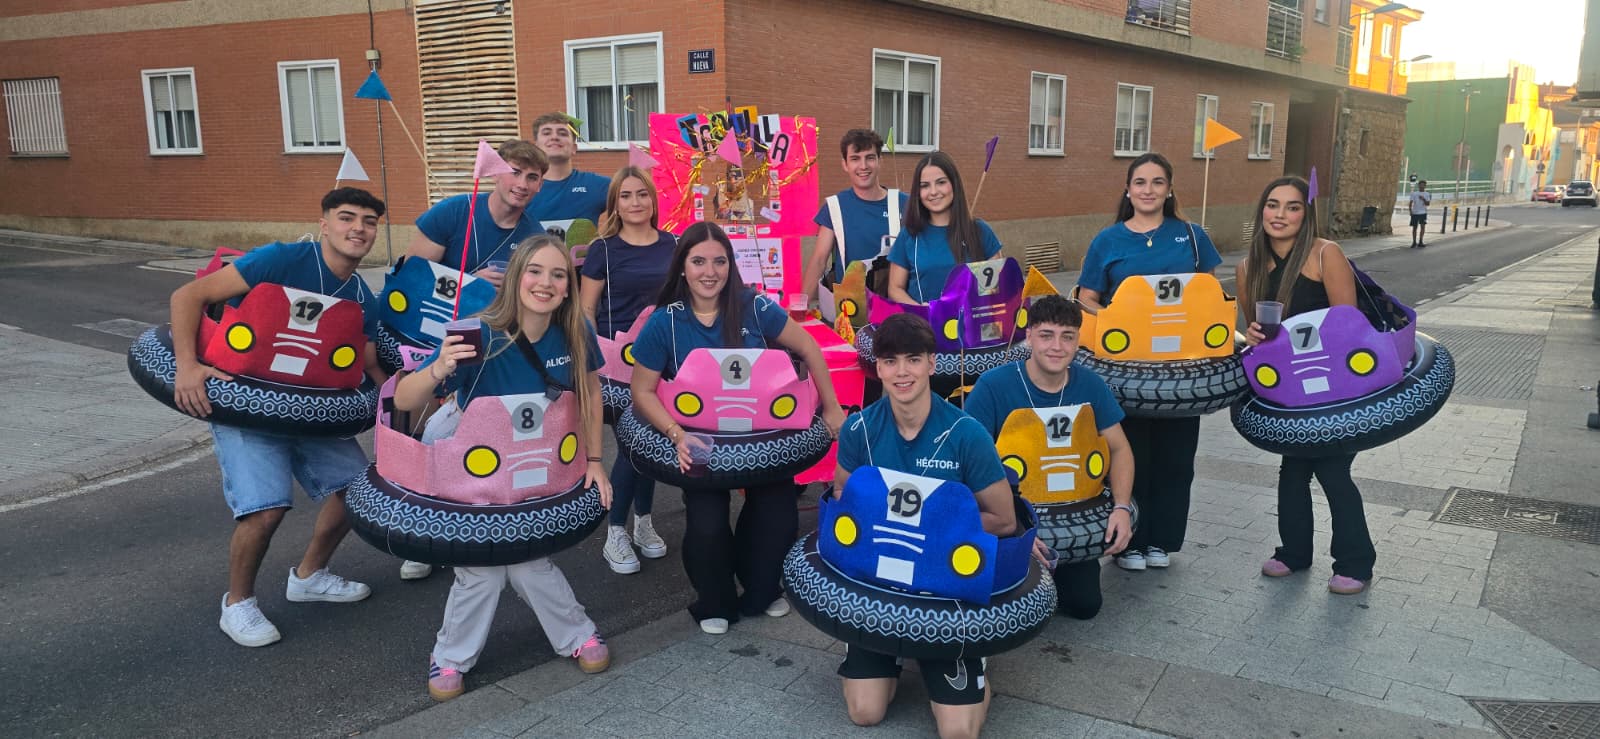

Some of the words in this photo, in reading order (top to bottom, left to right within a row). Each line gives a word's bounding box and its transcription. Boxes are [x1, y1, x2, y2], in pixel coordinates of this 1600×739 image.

[692, 61, 709, 70] NUEVA
[436, 276, 457, 299] 18
[982, 266, 994, 287] 9
[1158, 278, 1181, 300] 51
[295, 300, 324, 321] 17
[1296, 326, 1313, 348] 7
[545, 354, 571, 369] ALICIA
[729, 360, 742, 380] 4
[521, 407, 535, 429] 8
[1047, 416, 1071, 439] 12
[889, 487, 922, 517] 19
